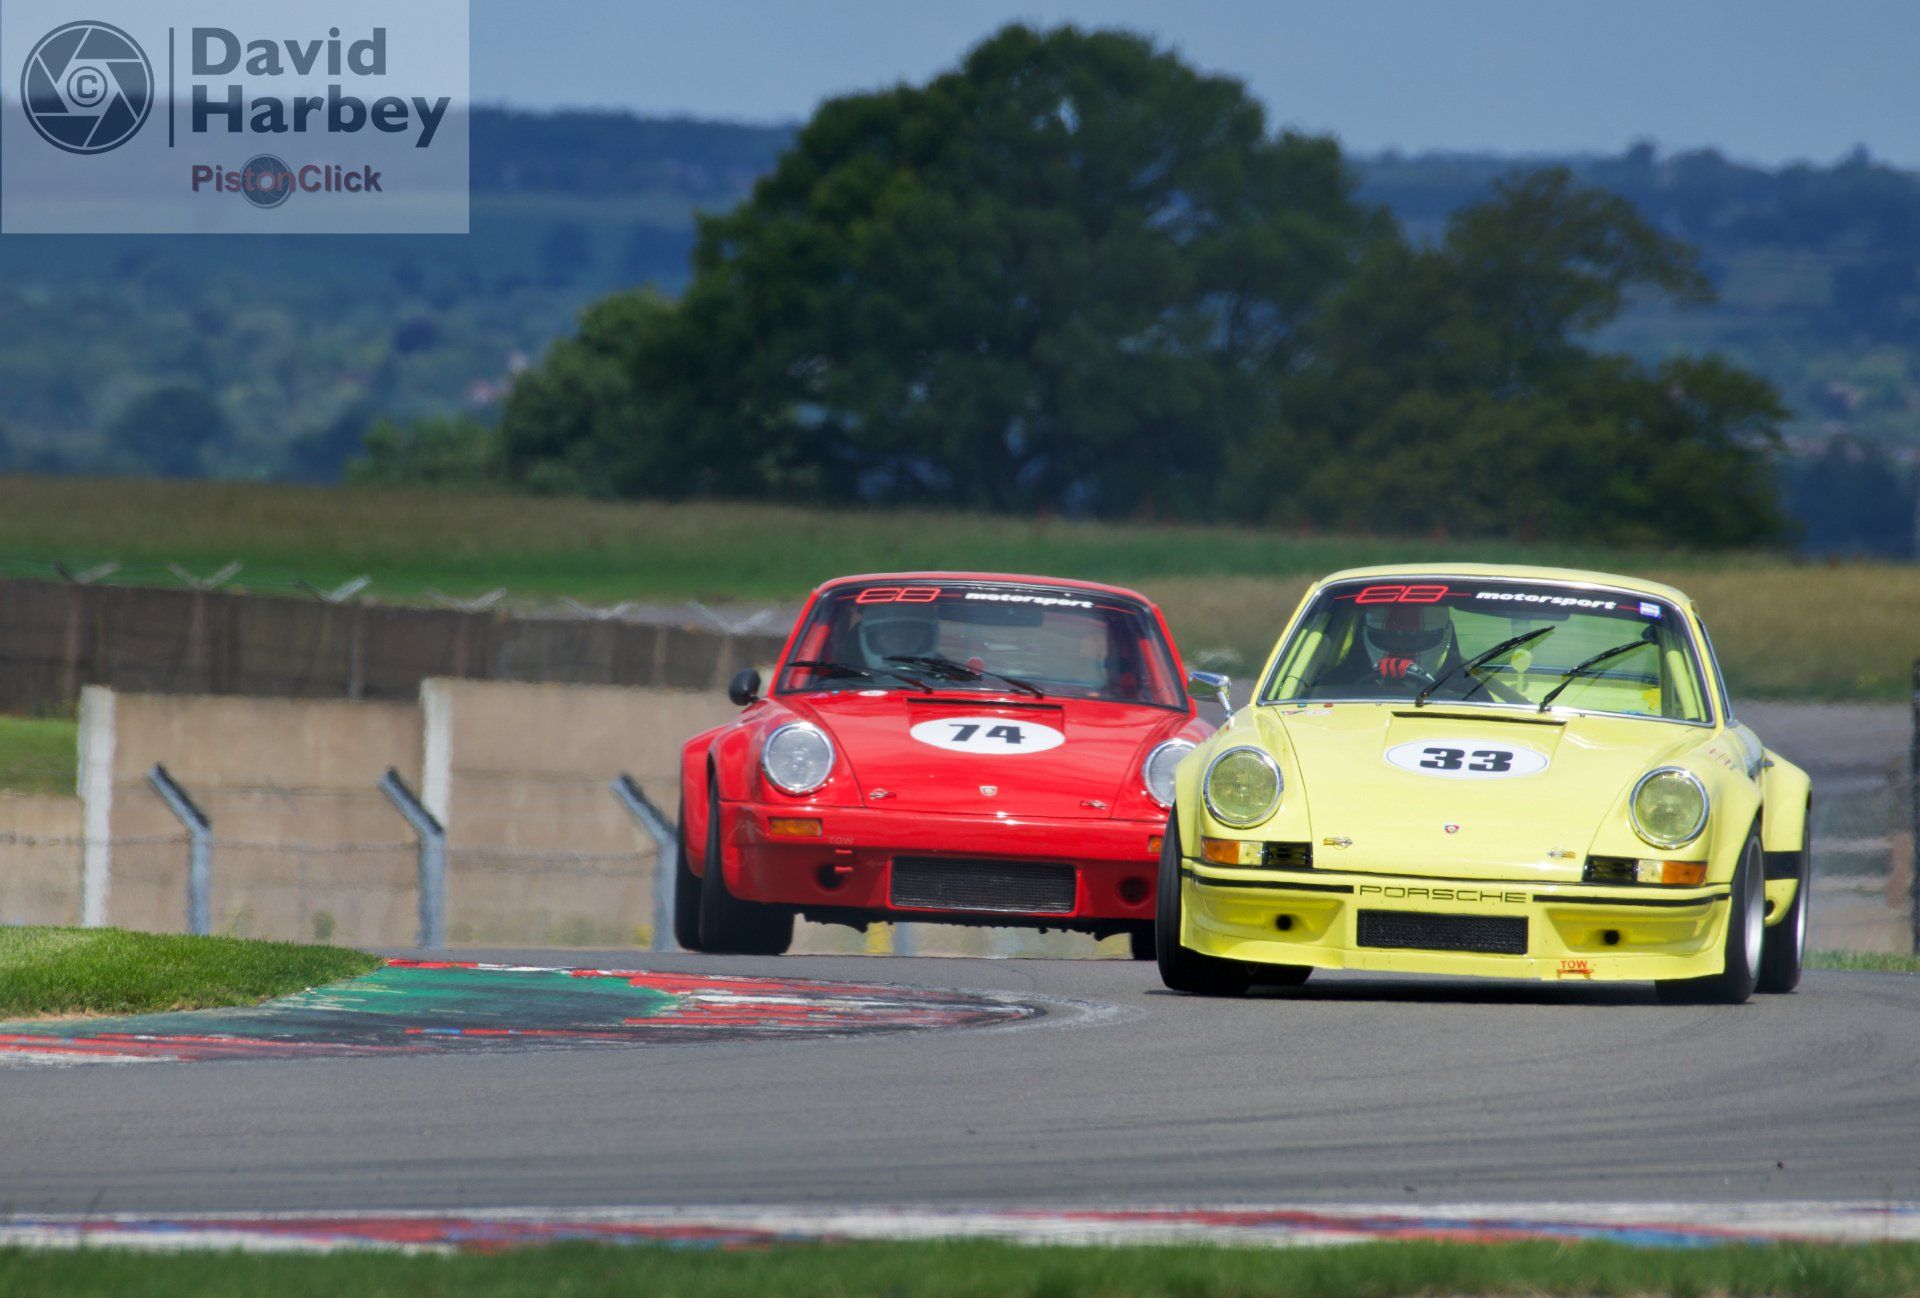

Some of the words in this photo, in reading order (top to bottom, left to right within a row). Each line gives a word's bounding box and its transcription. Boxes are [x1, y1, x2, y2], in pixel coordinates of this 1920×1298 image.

[965, 592, 1094, 608] motorsport
[1475, 591, 1617, 610] motorsport
[948, 723, 1026, 744] 74
[1419, 747, 1514, 772] 33
[1359, 884, 1527, 904] PORSCHE
[1560, 960, 1588, 969] TOW
